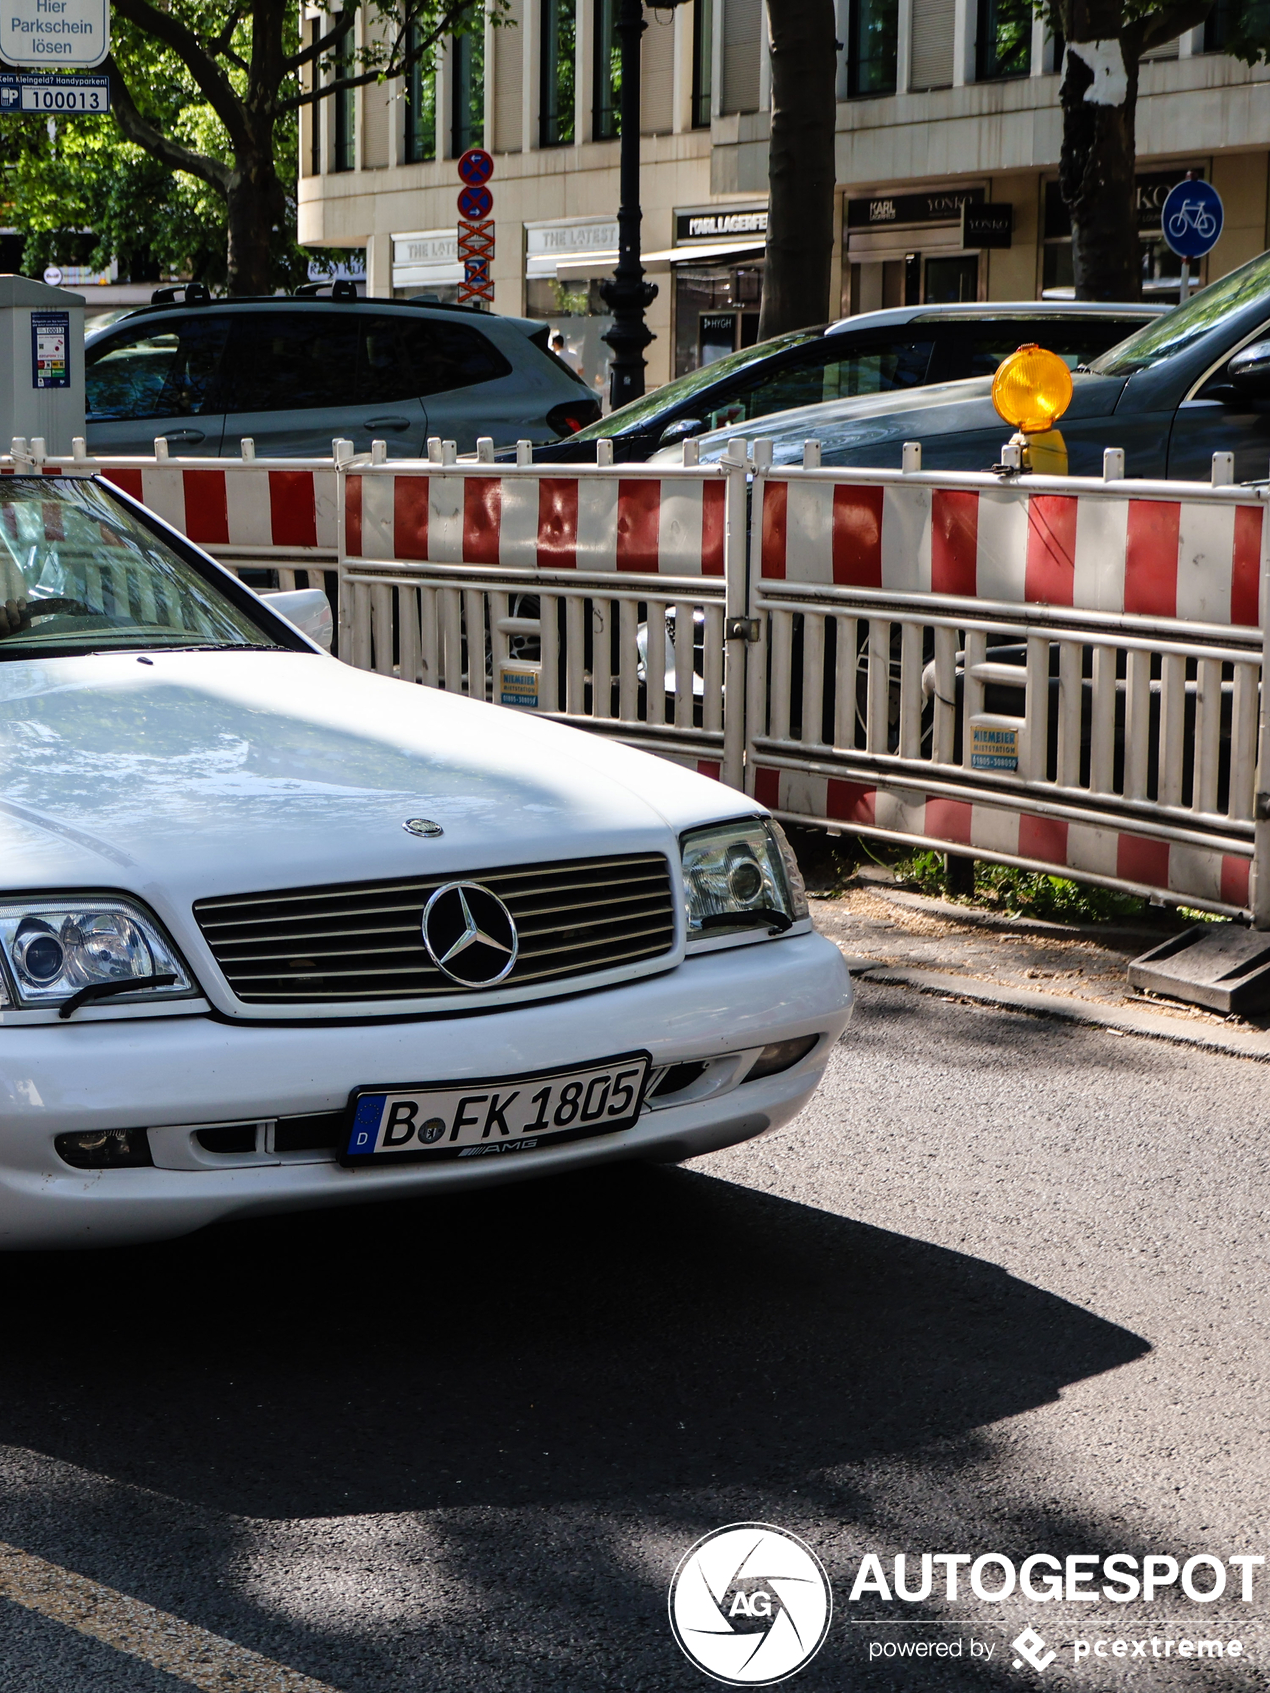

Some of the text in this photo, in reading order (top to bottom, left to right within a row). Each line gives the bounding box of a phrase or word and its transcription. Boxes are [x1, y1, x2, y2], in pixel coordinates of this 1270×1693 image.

[36, 0, 67, 13] Hier
[11, 18, 93, 34] Parkschein
[32, 38, 72, 54] lösen
[15, 76, 54, 85] Kleingeld?
[55, 77, 107, 86] Handyparken!
[32, 91, 100, 109] 100013
[870, 201, 895, 216] KARL
[542, 227, 616, 247] THE LATEST
[407, 243, 428, 258] THE
[711, 319, 733, 329] HYGH
[503, 674, 535, 685] NIEMEIER
[973, 730, 1015, 744] NIEMEIER
[973, 744, 1015, 754] MIETSTATION
[382, 1068, 640, 1147] B FK 1805
[356, 1132, 368, 1146] D
